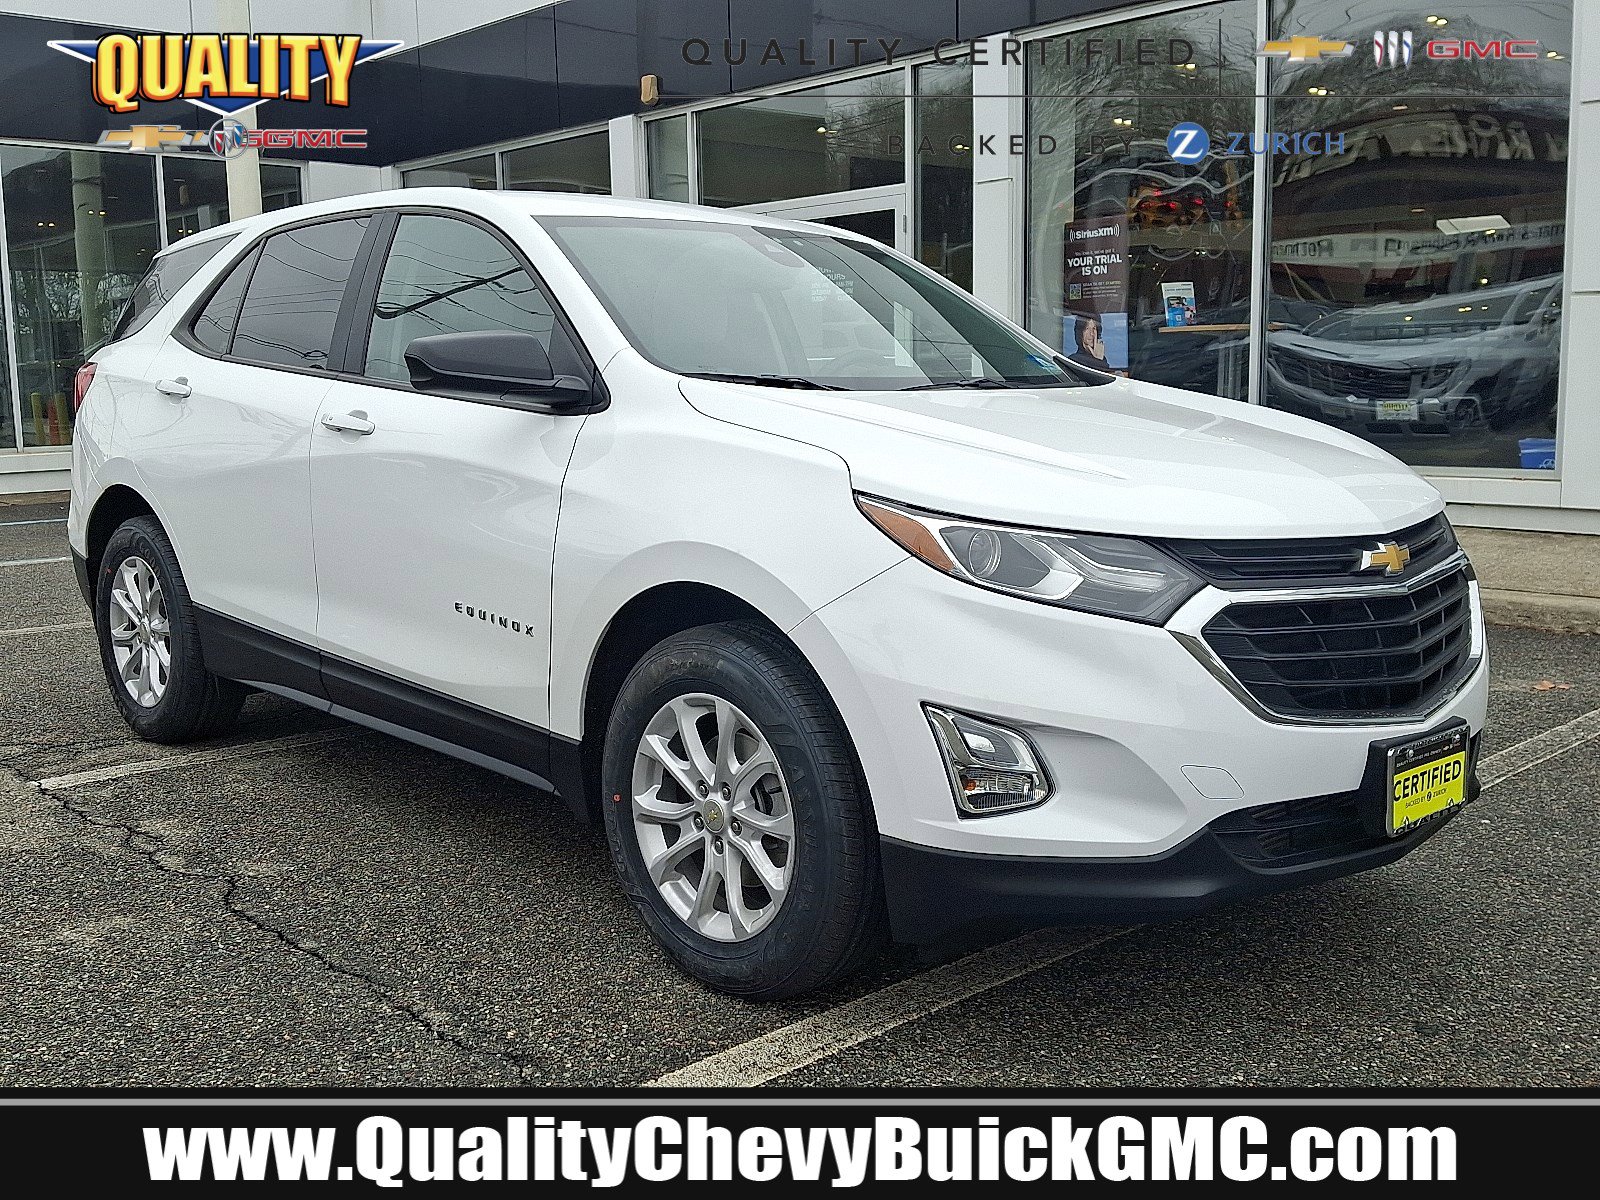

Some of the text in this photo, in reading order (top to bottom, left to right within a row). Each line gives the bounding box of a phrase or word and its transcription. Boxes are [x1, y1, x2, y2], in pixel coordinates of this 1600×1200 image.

[1067, 254, 1122, 267] YOUR TRIAL
[1082, 264, 1108, 276] IS ON
[454, 602, 534, 637] EQUINOX
[1394, 760, 1462, 802] CERTIFIED
